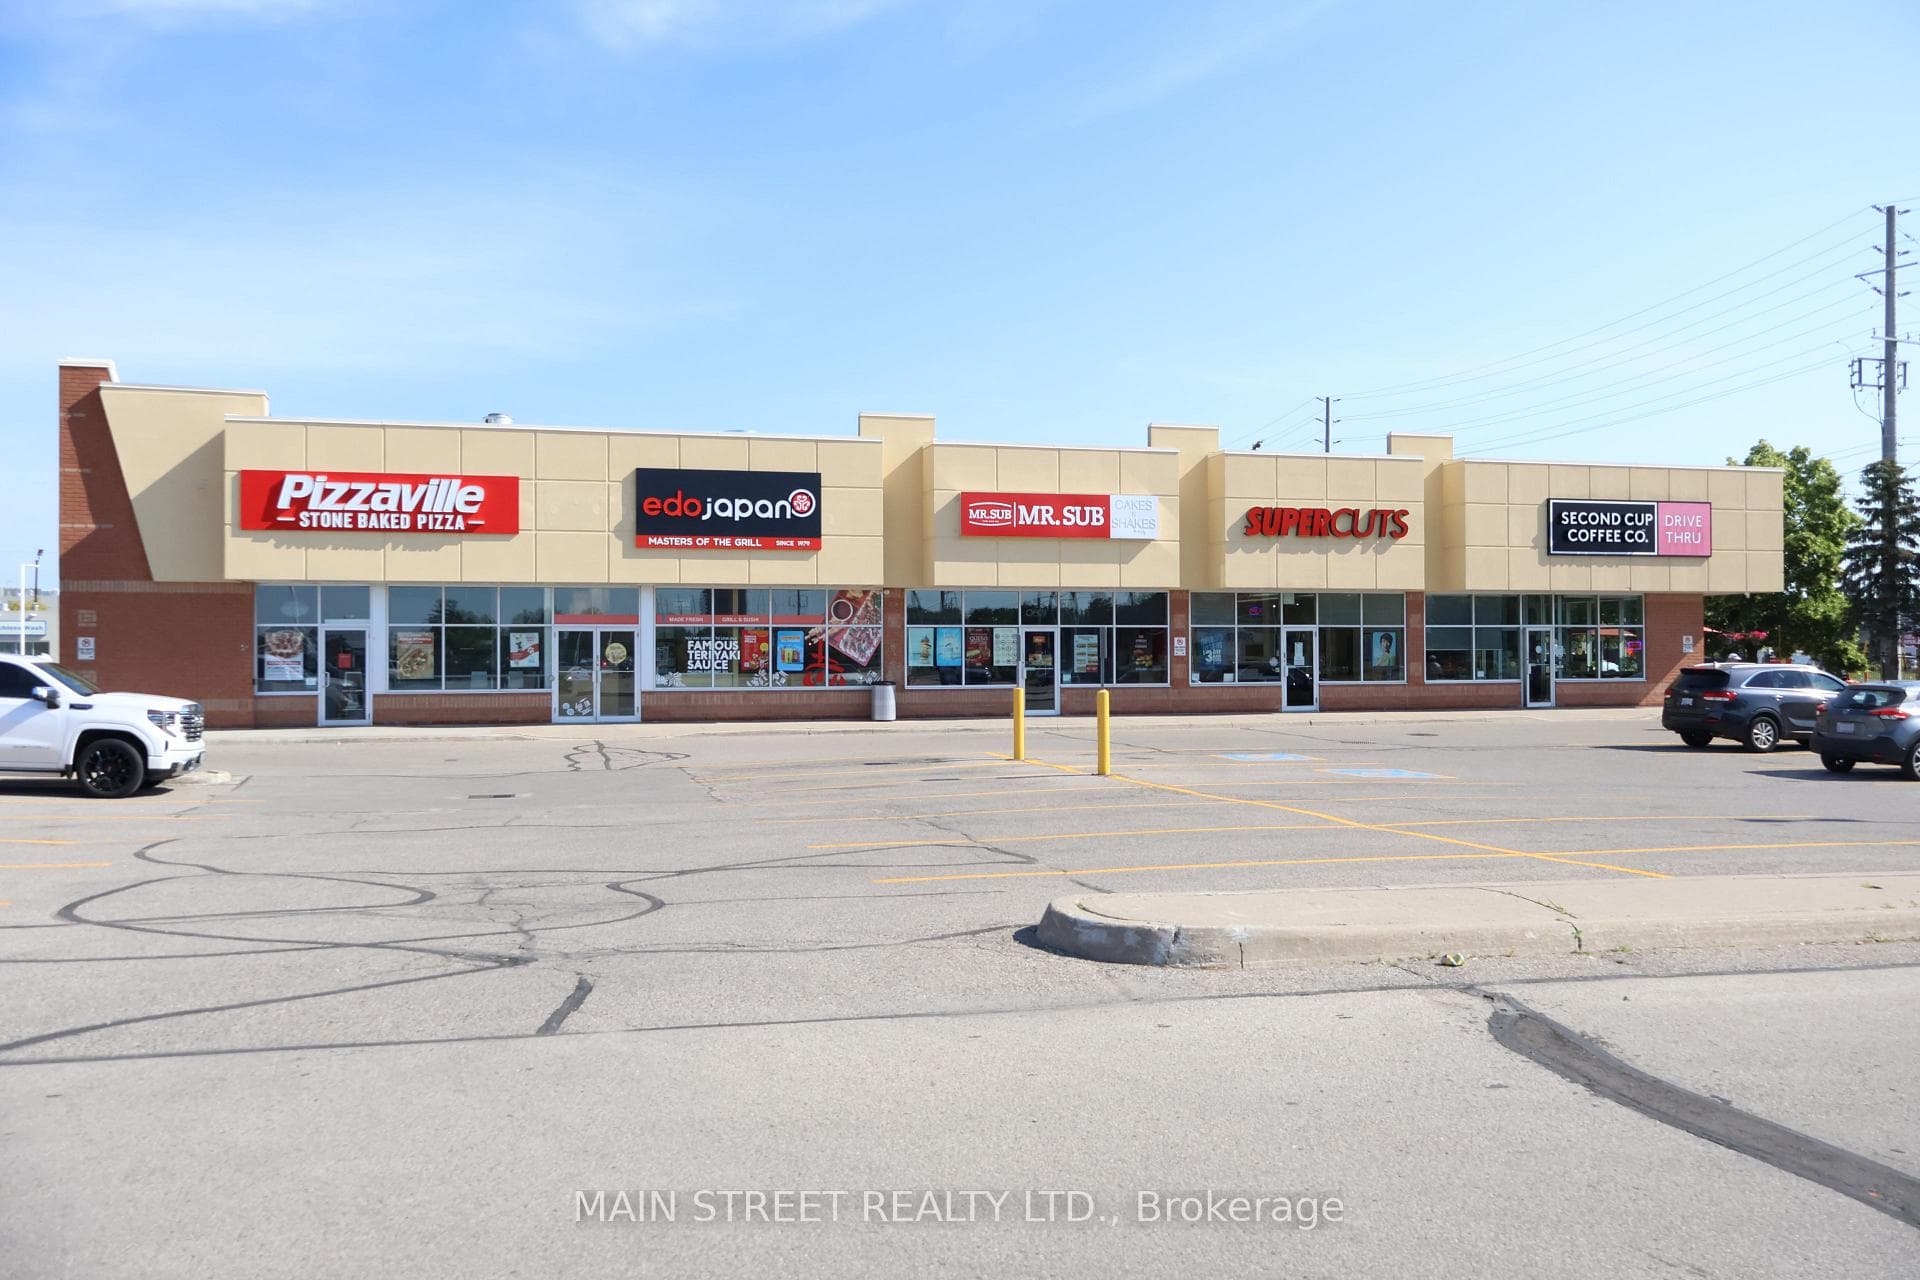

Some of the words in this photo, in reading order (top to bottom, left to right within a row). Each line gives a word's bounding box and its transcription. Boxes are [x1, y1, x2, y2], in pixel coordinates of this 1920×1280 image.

[277, 474, 485, 513] Pizzaville
[1115, 500, 1153, 511] CAKES
[299, 512, 353, 529] STONE
[358, 513, 411, 530] BAKED
[417, 514, 465, 531] PIZZA
[1112, 517, 1156, 530] SHAKES
[1244, 506, 1410, 539] SUPERCUTS
[1561, 511, 1621, 526] SECOND
[1624, 513, 1654, 527] CUP
[1664, 515, 1703, 528] DRIVE
[648, 537, 693, 546] MASTERS
[696, 538, 709, 546] OF
[713, 538, 731, 546] THE
[735, 539, 762, 547] GRILL
[1567, 528, 1622, 543] COFFEE
[1624, 530, 1649, 543] CO.
[1665, 531, 1701, 544] THRU
[687, 640, 739, 651] FAMOUS
[687, 650, 741, 660] TERIYAKI
[687, 660, 729, 670] SAUCE
